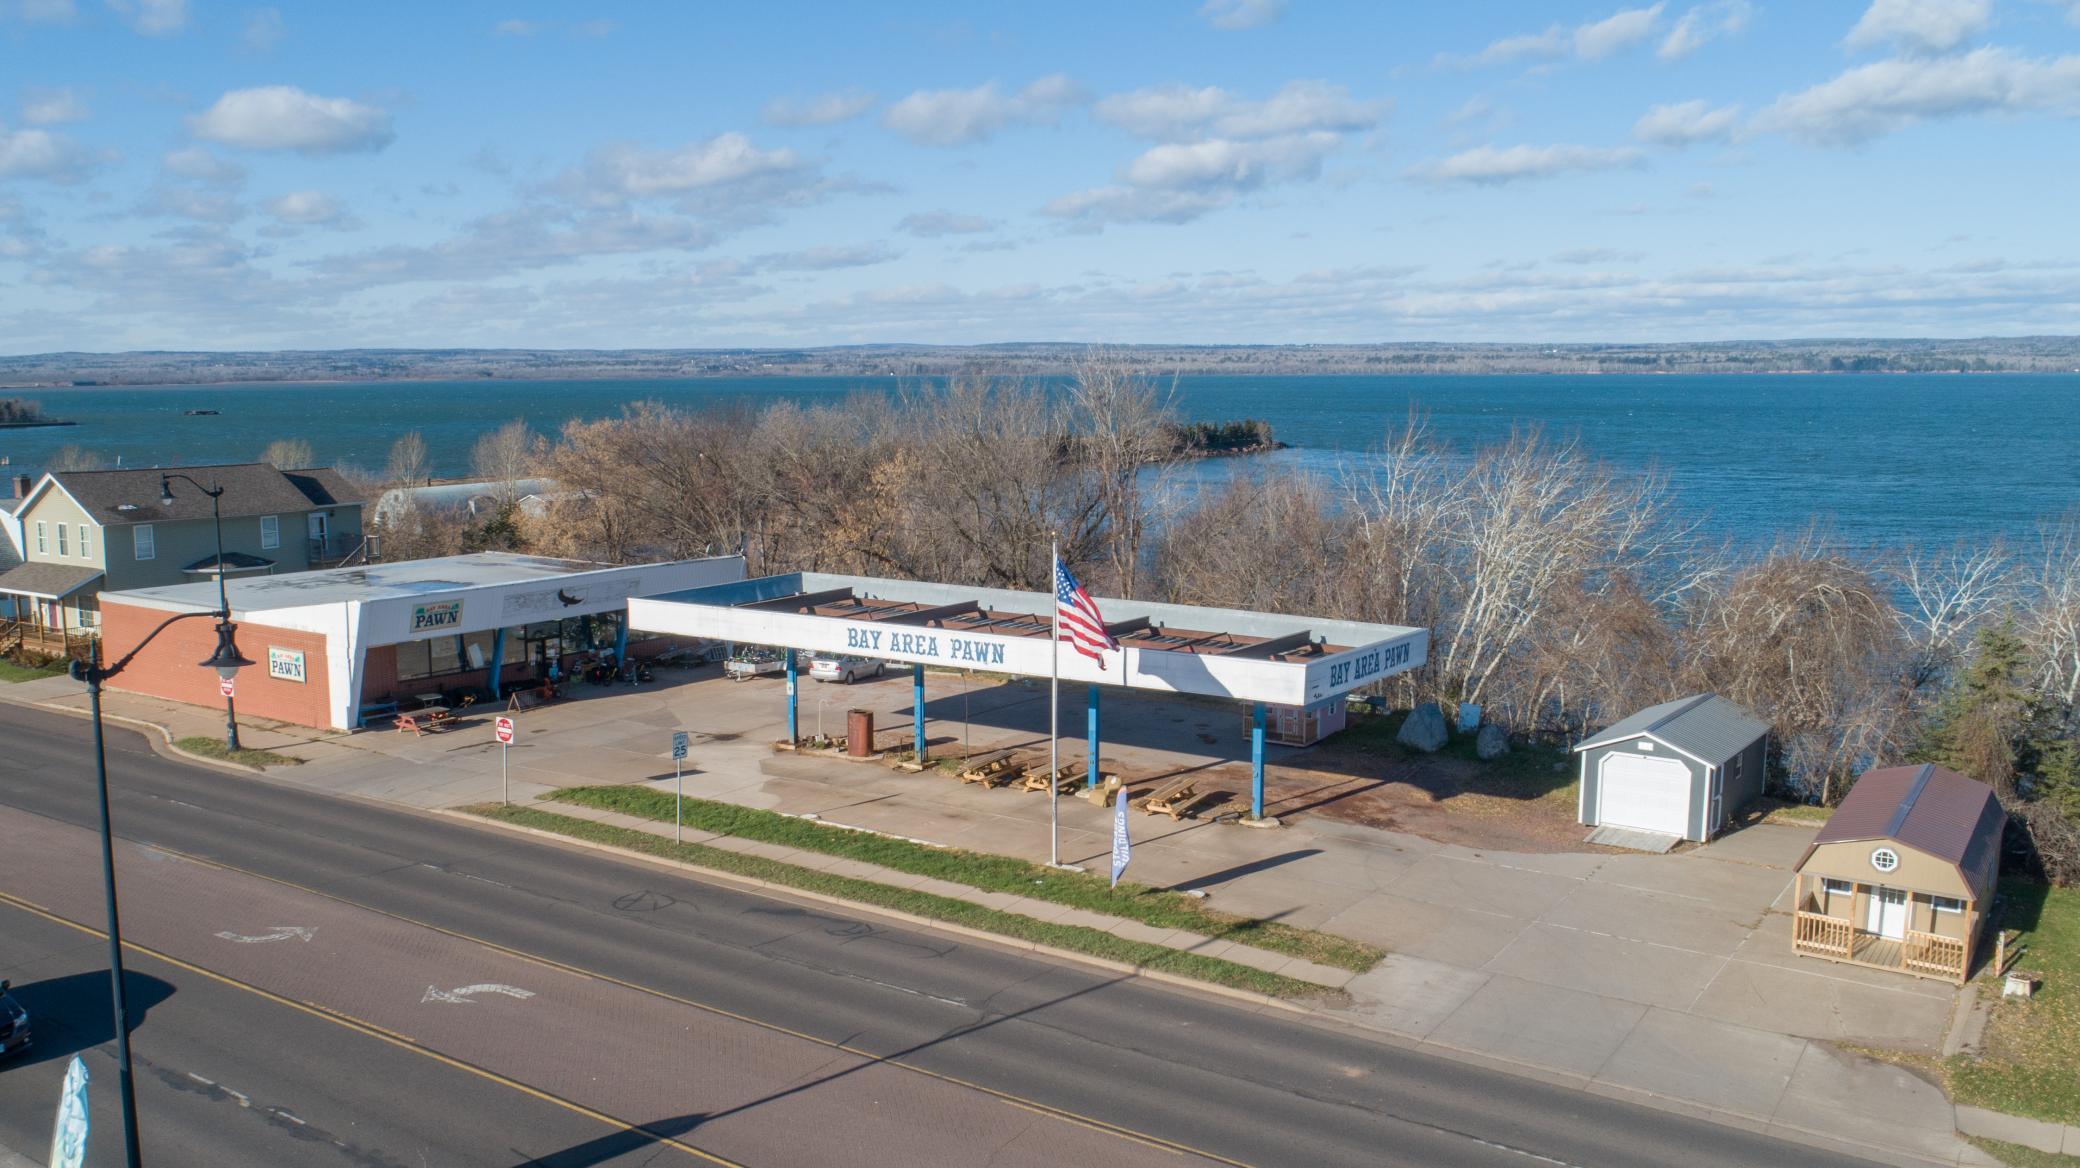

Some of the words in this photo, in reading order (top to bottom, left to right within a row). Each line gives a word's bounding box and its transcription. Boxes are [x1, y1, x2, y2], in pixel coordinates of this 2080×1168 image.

[415, 611, 459, 628] PAWN
[847, 627, 882, 650] BAY
[890, 632, 939, 657] AREA
[950, 638, 1005, 664] PAWN
[272, 660, 302, 677] PAWN
[1330, 661, 1351, 687] BAY
[1354, 651, 1380, 680] AREA
[1384, 643, 1410, 670] PAWN
[674, 745, 687, 757] 25
